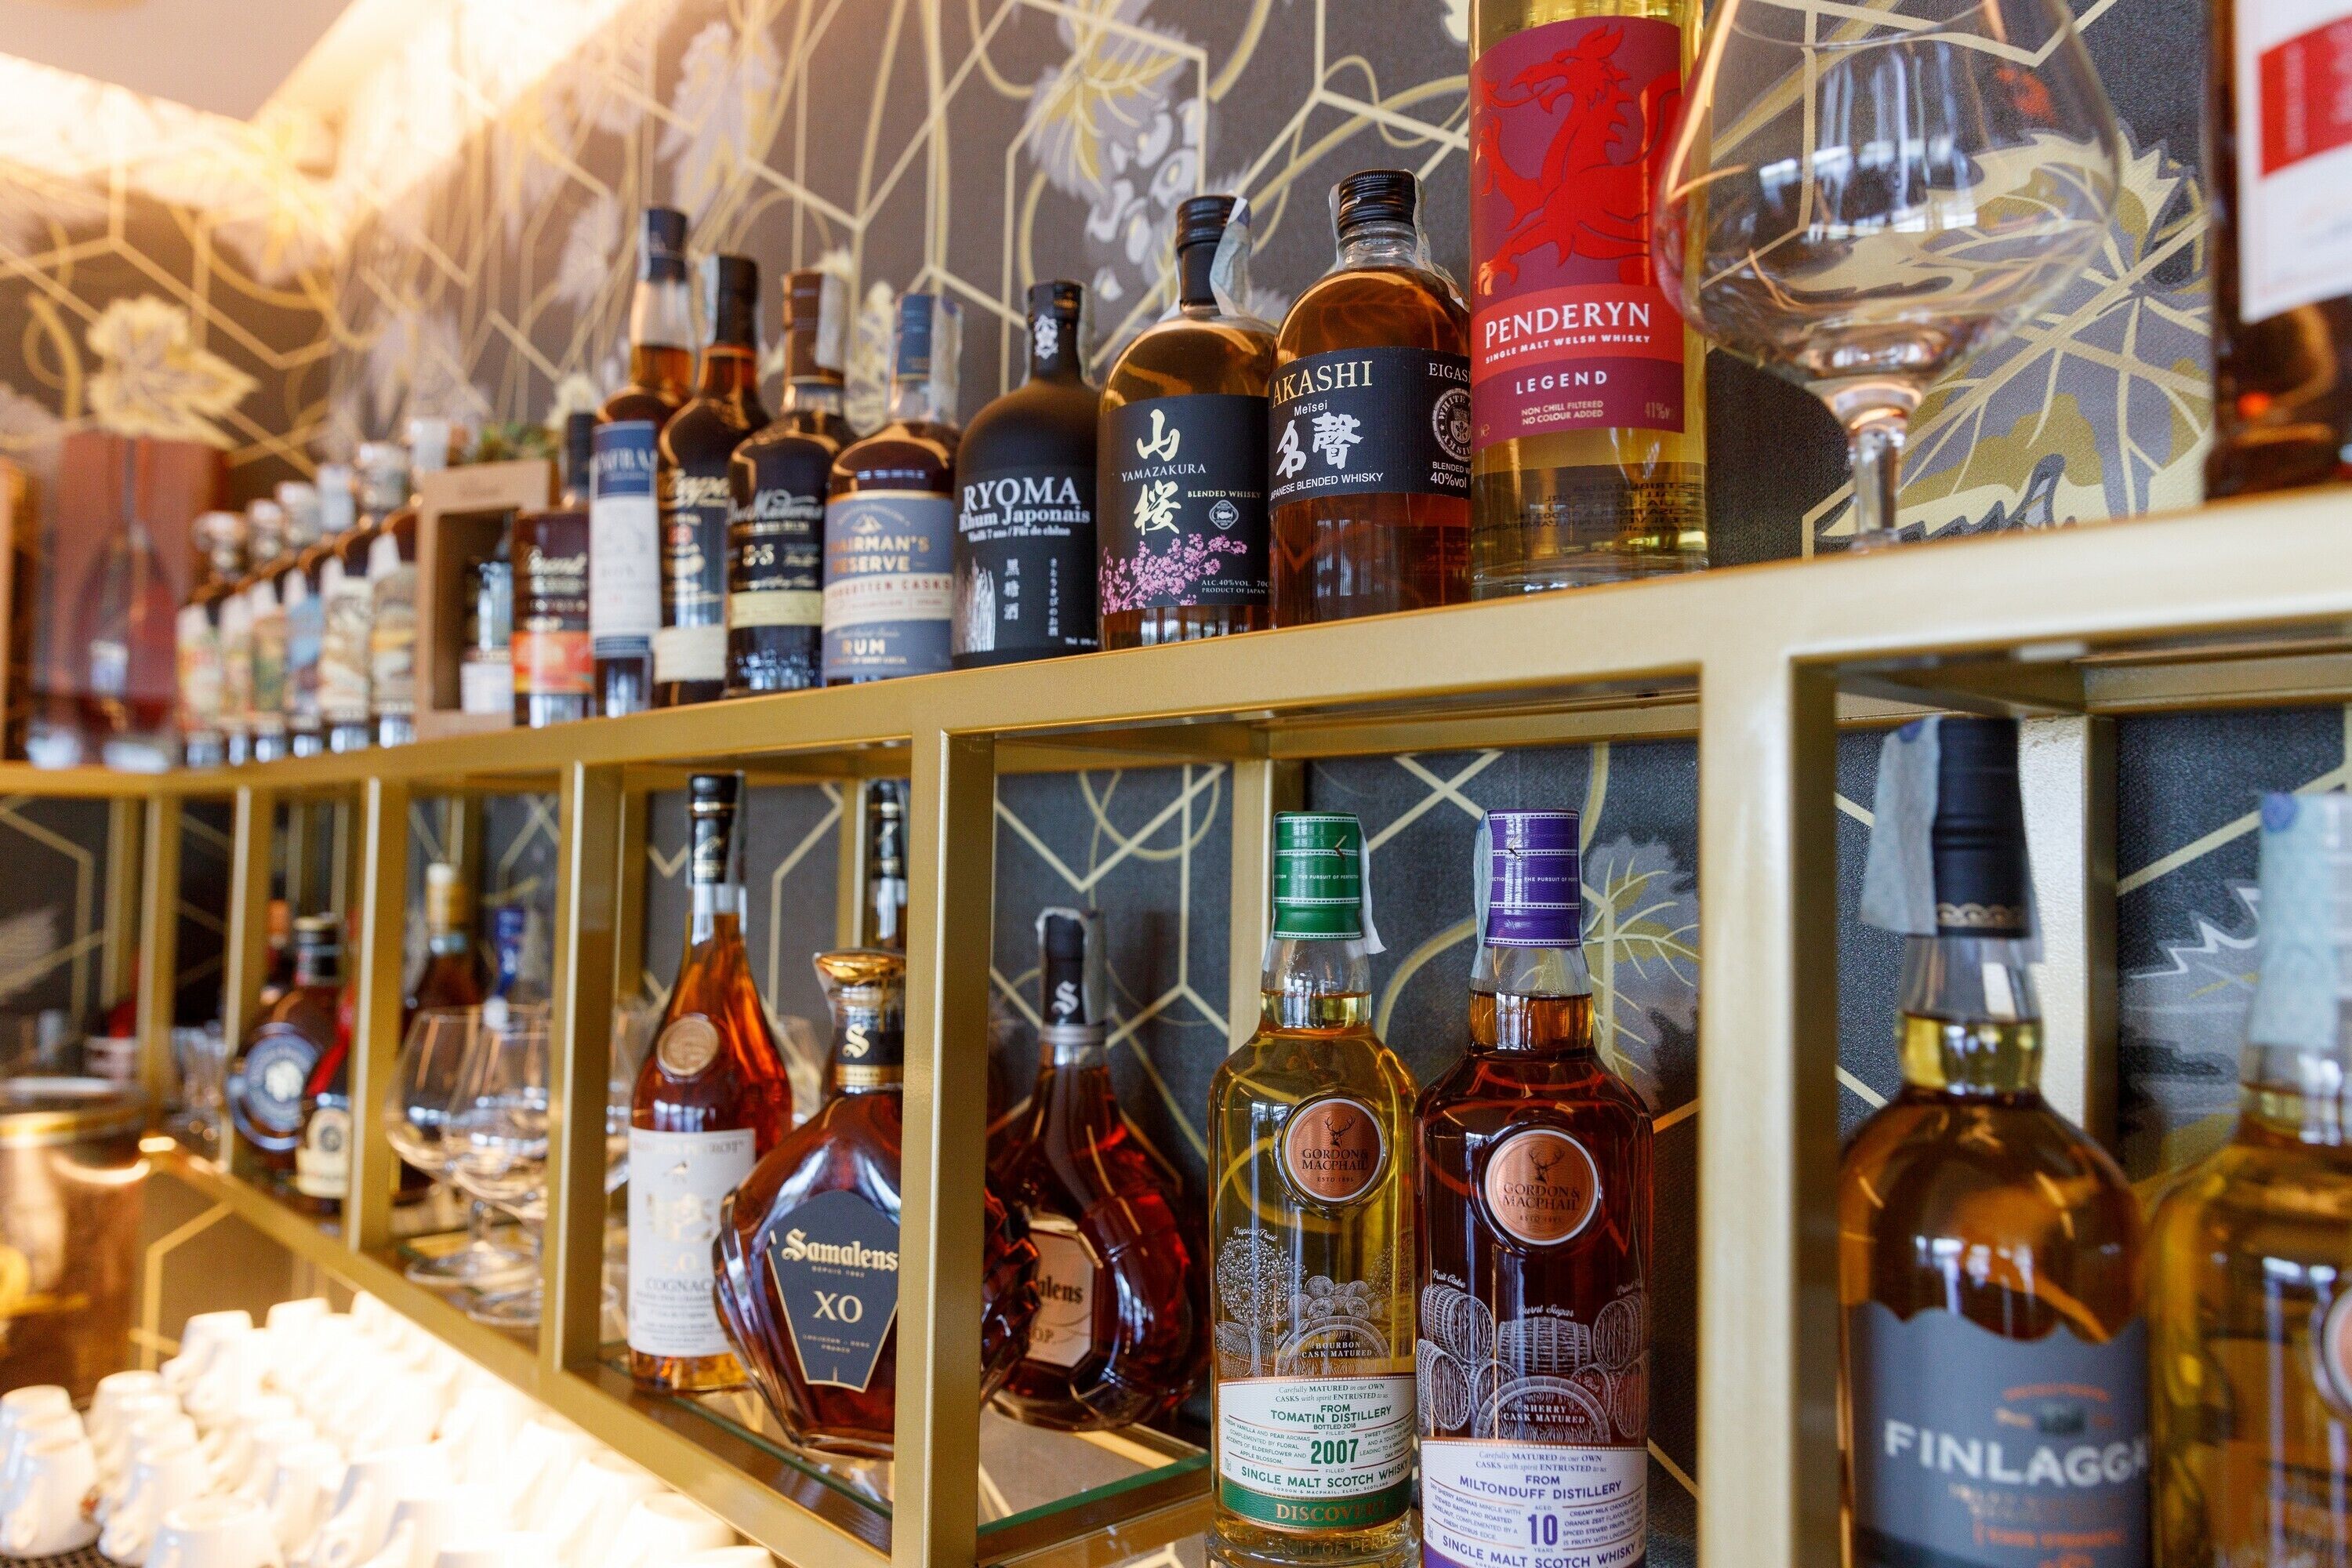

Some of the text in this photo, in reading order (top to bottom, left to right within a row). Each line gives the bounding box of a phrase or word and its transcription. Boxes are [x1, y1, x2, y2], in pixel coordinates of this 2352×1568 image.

[1485, 302, 1650, 349] PENDERYN
[1485, 334, 1651, 365] SINGLE MALT WELSH WHISKY
[1272, 360, 1374, 409] AKASHI
[1515, 370, 1608, 395] LEGEND
[1294, 399, 1328, 418] Meïsei
[1437, 395, 1465, 420] WHITE
[1521, 399, 1604, 416] NON CHILL FILTERED
[1522, 408, 1604, 426] NO COLOUR ADDED
[1136, 408, 1181, 462] 山
[1121, 463, 1207, 483] YAMAZAKURA
[1432, 461, 1465, 474] BLENDED
[1269, 472, 1385, 502] JAPANESE BLENDED WHISKY
[1429, 471, 1468, 489] 40%vol
[963, 476, 1082, 511] RYOMA
[1187, 489, 1261, 499] BLENDED WHISKY
[958, 505, 1091, 533] Rhum Japonais
[1030, 524, 1043, 537] de
[829, 535, 931, 555] HAIRMAN'S
[833, 554, 911, 575] RESERVE
[901, 577, 953, 592] CASKS
[841, 639, 887, 655] RUM
[1301, 1148, 1361, 1160] GORDON
[1301, 1160, 1369, 1171] MACPHAIL
[1503, 1182, 1570, 1198] GORDON
[1502, 1195, 1579, 1210] MACPHAIL
[1233, 1225, 1279, 1243] Tropical Fruit
[781, 1228, 898, 1272] Samalens
[1432, 1269, 1447, 1282] Fruit
[645, 1276, 715, 1294] COGNAC
[1039, 1274, 1083, 1304] alens
[812, 1290, 863, 1323] XO
[1545, 1303, 1575, 1318] Sugar
[1301, 1349, 1373, 1359] CASK MATURED
[1279, 1385, 1308, 1394] Carefully
[1316, 1394, 1332, 1403] spirit
[1333, 1392, 1377, 1401] ENTRUSTED
[1270, 1409, 1326, 1423] TOMATIN
[1331, 1404, 1392, 1424] DISTILLERY
[1320, 1403, 1351, 1413] FROM
[1523, 1404, 1567, 1414] SHERRY
[1503, 1413, 1585, 1425] CASK MATURED
[1236, 1423, 1256, 1434] VANILLA
[1257, 1428, 1269, 1437] AND
[1364, 1430, 1381, 1439] SWEET
[1229, 1428, 1267, 1445] COMPLEMENTED
[1276, 1441, 1300, 1450] FLORAL
[1240, 1450, 1256, 1459] APPLE
[1251, 1445, 1292, 1457] ELDERFLOWER
[1310, 1438, 1359, 1465] 2007
[1359, 1447, 1381, 1457] LEADING
[1479, 1451, 1511, 1461] Carefully
[1512, 1452, 1558, 1461] MATURED
[1241, 1460, 1409, 1489] SINGLE MALT SCOTCH WHISKY
[1475, 1461, 1502, 1470] CASKS
[1539, 1463, 1592, 1472] ENTRUSTED
[1459, 1474, 1623, 1501] MILTONDUFF DISTILLERY
[1525, 1474, 1560, 1485] FROM
[1272, 1486, 1298, 1494] GORDON
[1455, 1494, 1478, 1507] AROMAS
[1479, 1502, 1503, 1513] MINGLE
[1469, 1510, 1483, 1519] AND
[1484, 1513, 1513, 1524] ROASTED
[1570, 1508, 1594, 1518] CREAMY
[1455, 1513, 1502, 1533] COMPLEMENTED
[1527, 1513, 1558, 1546] 10
[1564, 1519, 1590, 1528] ORANGE
[1442, 1534, 1484, 1560] SINGLE
[1490, 1551, 1528, 1568] MALT
[1534, 1555, 1591, 1568] SCOTCH
[1596, 1541, 1636, 1566] WHISKY
